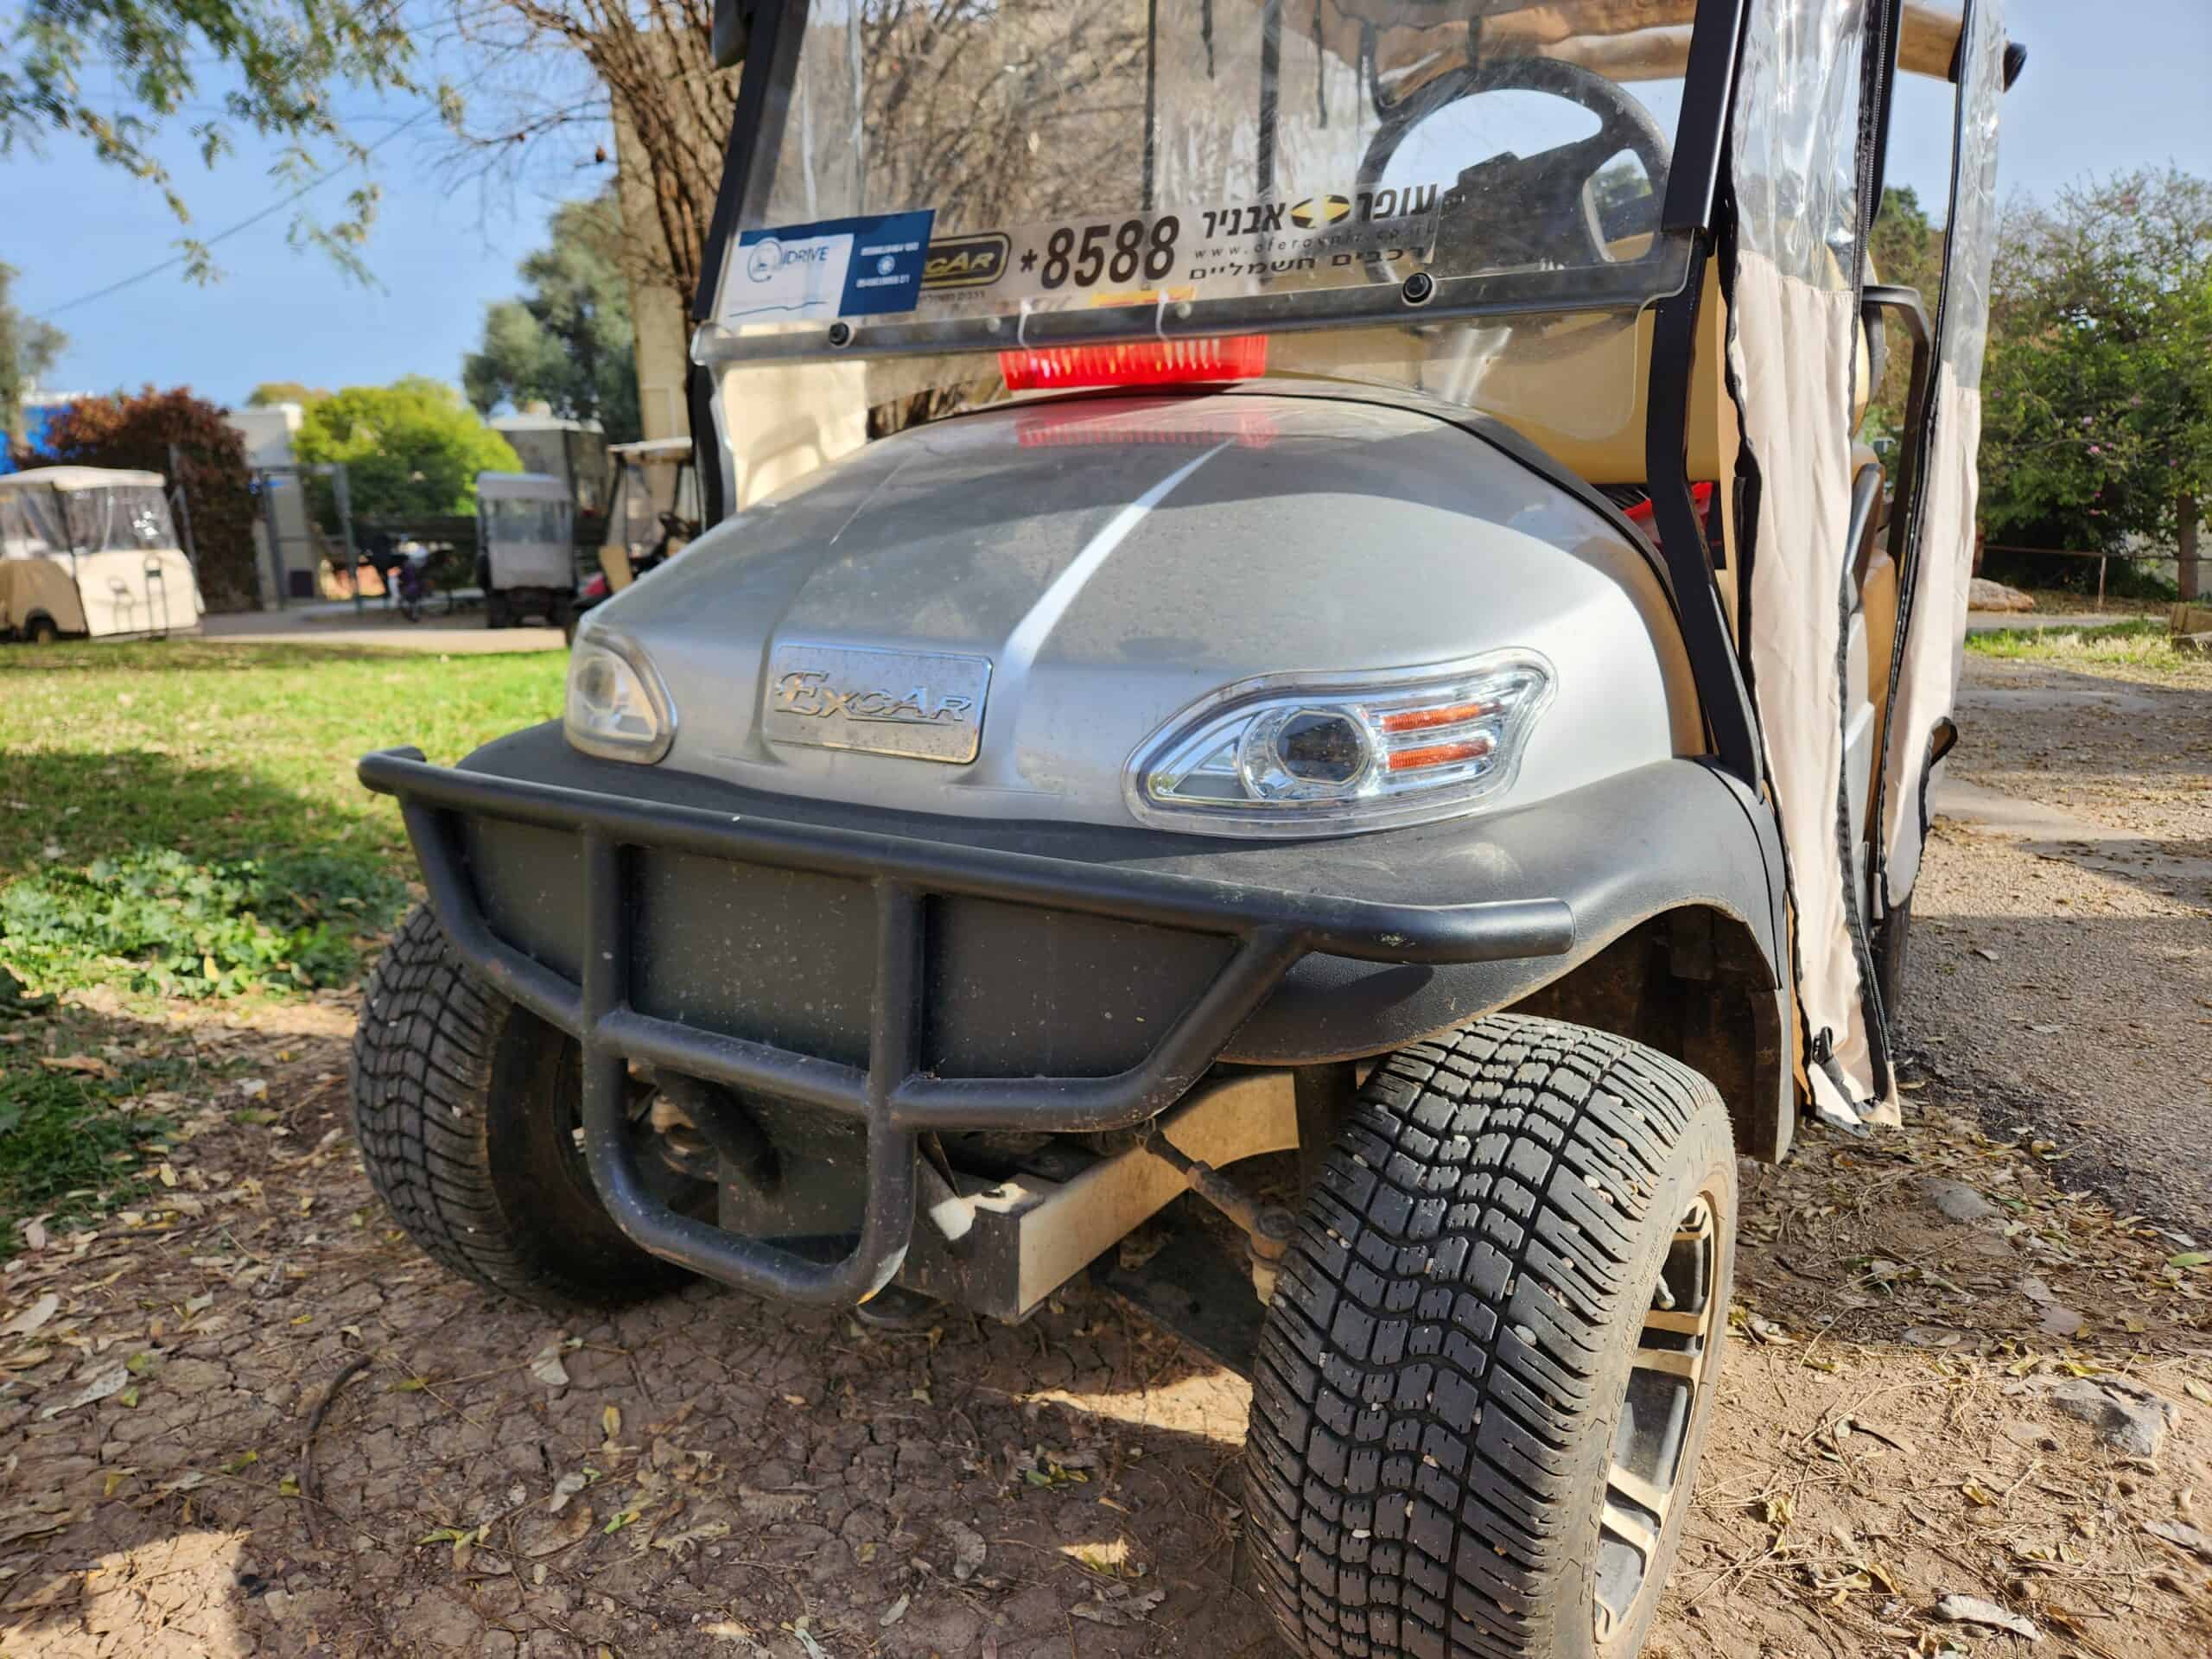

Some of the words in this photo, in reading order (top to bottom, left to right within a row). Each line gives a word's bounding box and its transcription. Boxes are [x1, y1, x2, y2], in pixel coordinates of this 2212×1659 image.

[1357, 184, 1438, 222] עופר
[1202, 202, 1286, 238] אבניר
[925, 251, 995, 274] CAR
[1189, 257, 1316, 280] חשמליים
[1332, 247, 1425, 267] רכבים
